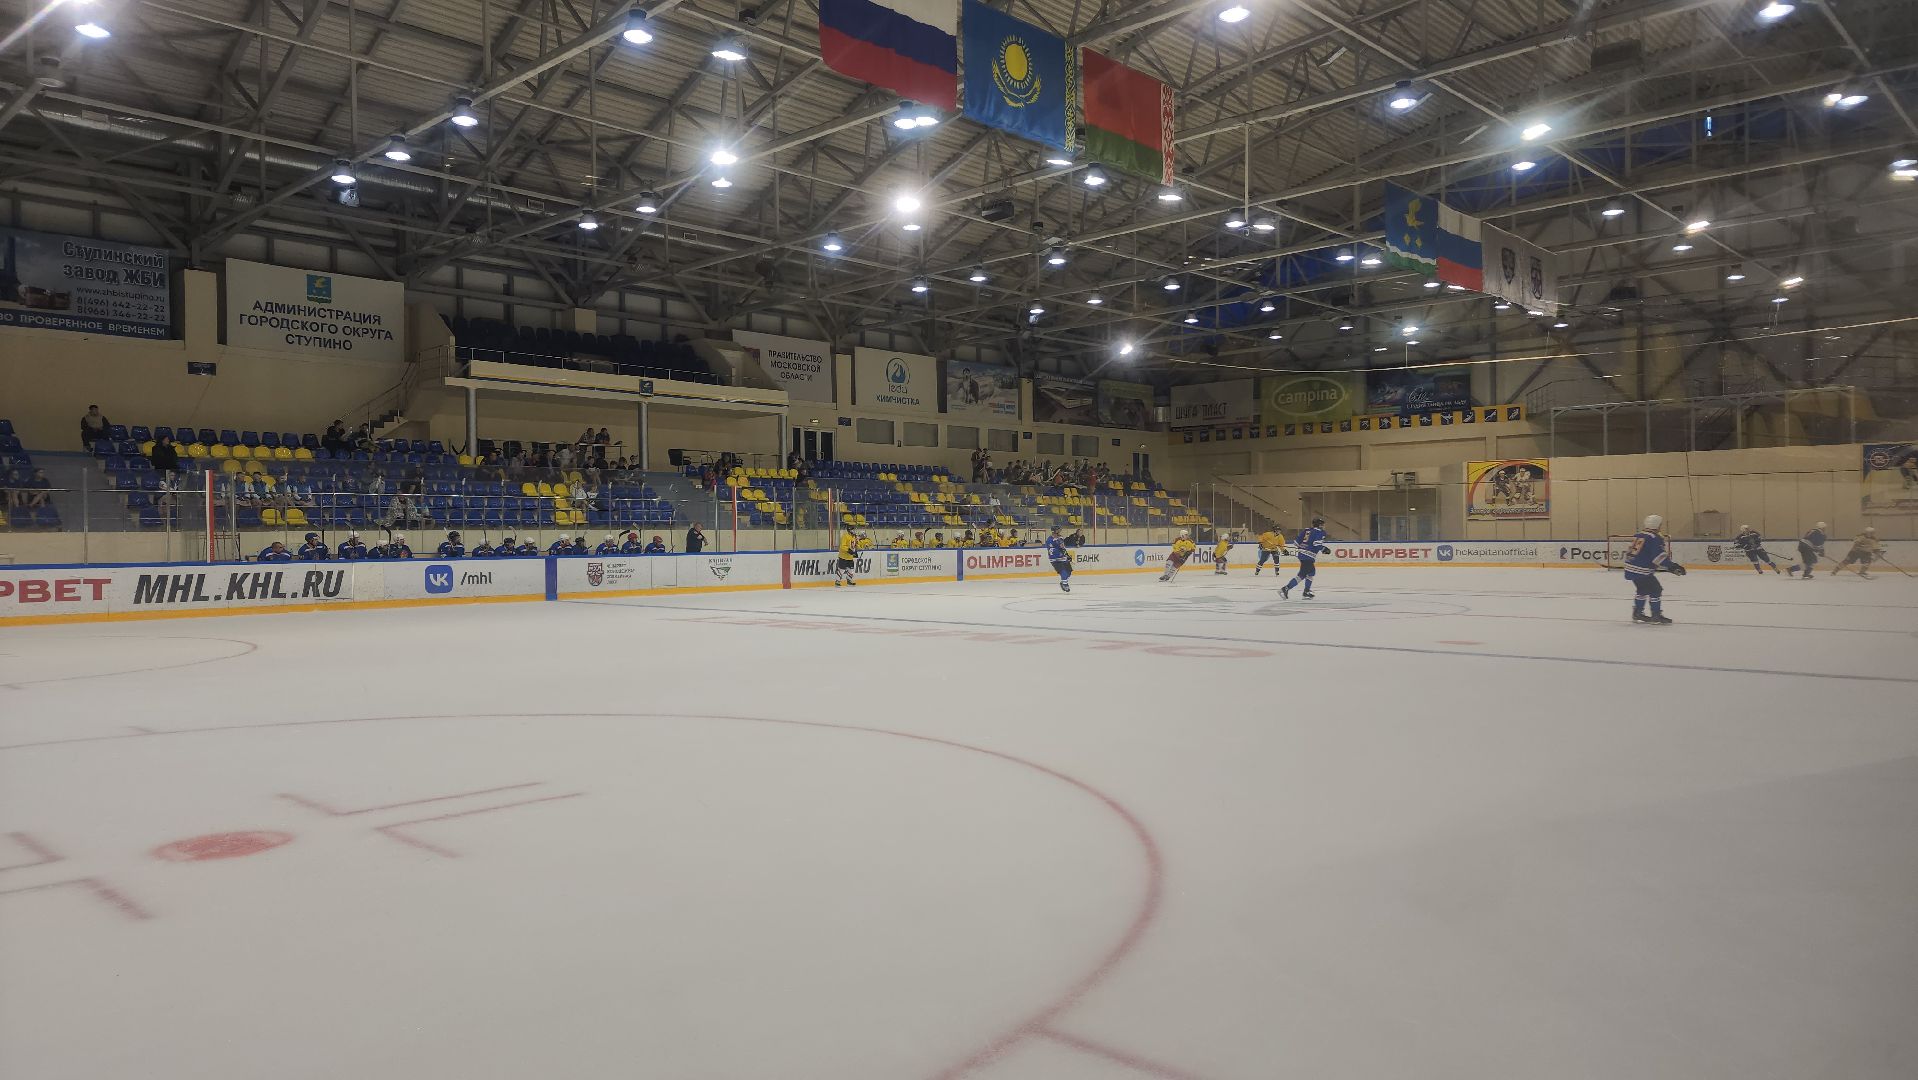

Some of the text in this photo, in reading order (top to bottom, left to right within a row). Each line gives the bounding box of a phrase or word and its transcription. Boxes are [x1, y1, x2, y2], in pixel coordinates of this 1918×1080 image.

[62, 241, 164, 269] Ступинский
[63, 264, 165, 289] завод ЖБИ
[252, 300, 382, 325] АДМИНИСТРАЦИЯ
[20, 313, 104, 331] ПРОВЕРЕННОЕ
[108, 322, 166, 337] ВРЕМЕНЕМ
[239, 313, 394, 341] ГОРОДСКОГО ОКРУГА
[285, 333, 354, 351] СТУПИНО
[768, 349, 823, 364] ПРАВИТЕЛЬСТВО
[770, 360, 822, 374] МОСКОВСКОЙ
[967, 555, 1042, 570] OLIMPBET
[1076, 553, 1100, 563] БАНК
[1334, 548, 1432, 560] OLIMPBET
[133, 570, 345, 604] MHL.KHL.RU
[460, 571, 492, 585] /mhl
